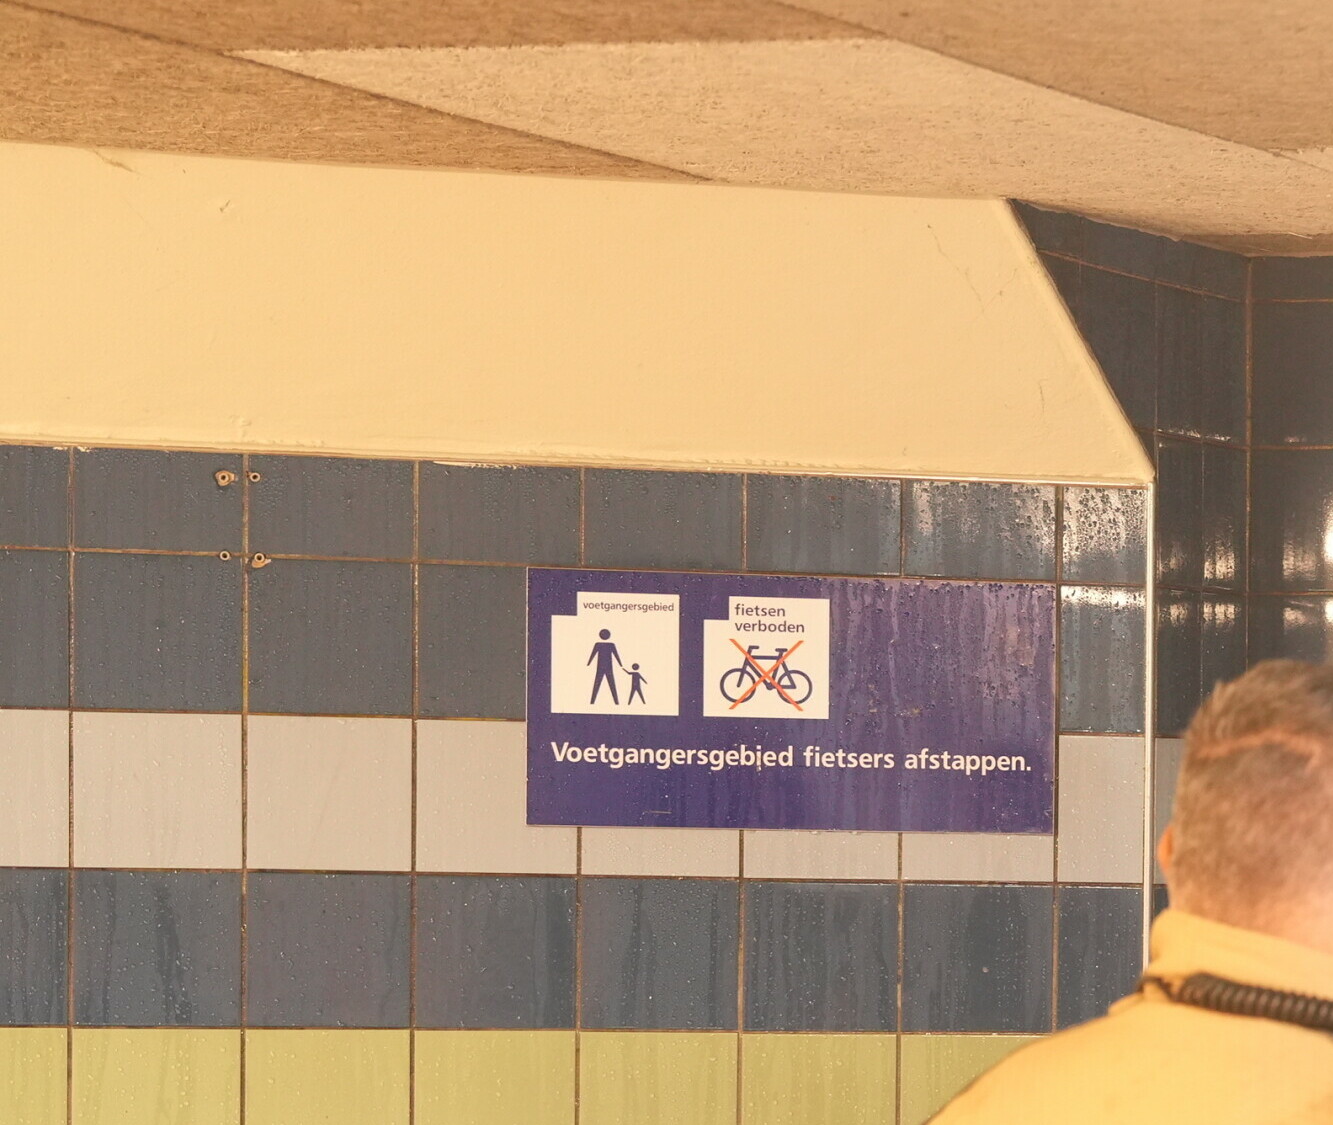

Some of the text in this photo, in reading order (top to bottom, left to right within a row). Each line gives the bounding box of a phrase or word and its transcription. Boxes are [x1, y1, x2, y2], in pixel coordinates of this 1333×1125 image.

[582, 601, 675, 613] voetgangersgebied
[734, 603, 786, 618] fietsen
[734, 620, 805, 634] verboden
[550, 741, 1032, 776] Voetgangersgebied fietsers afstappen.
